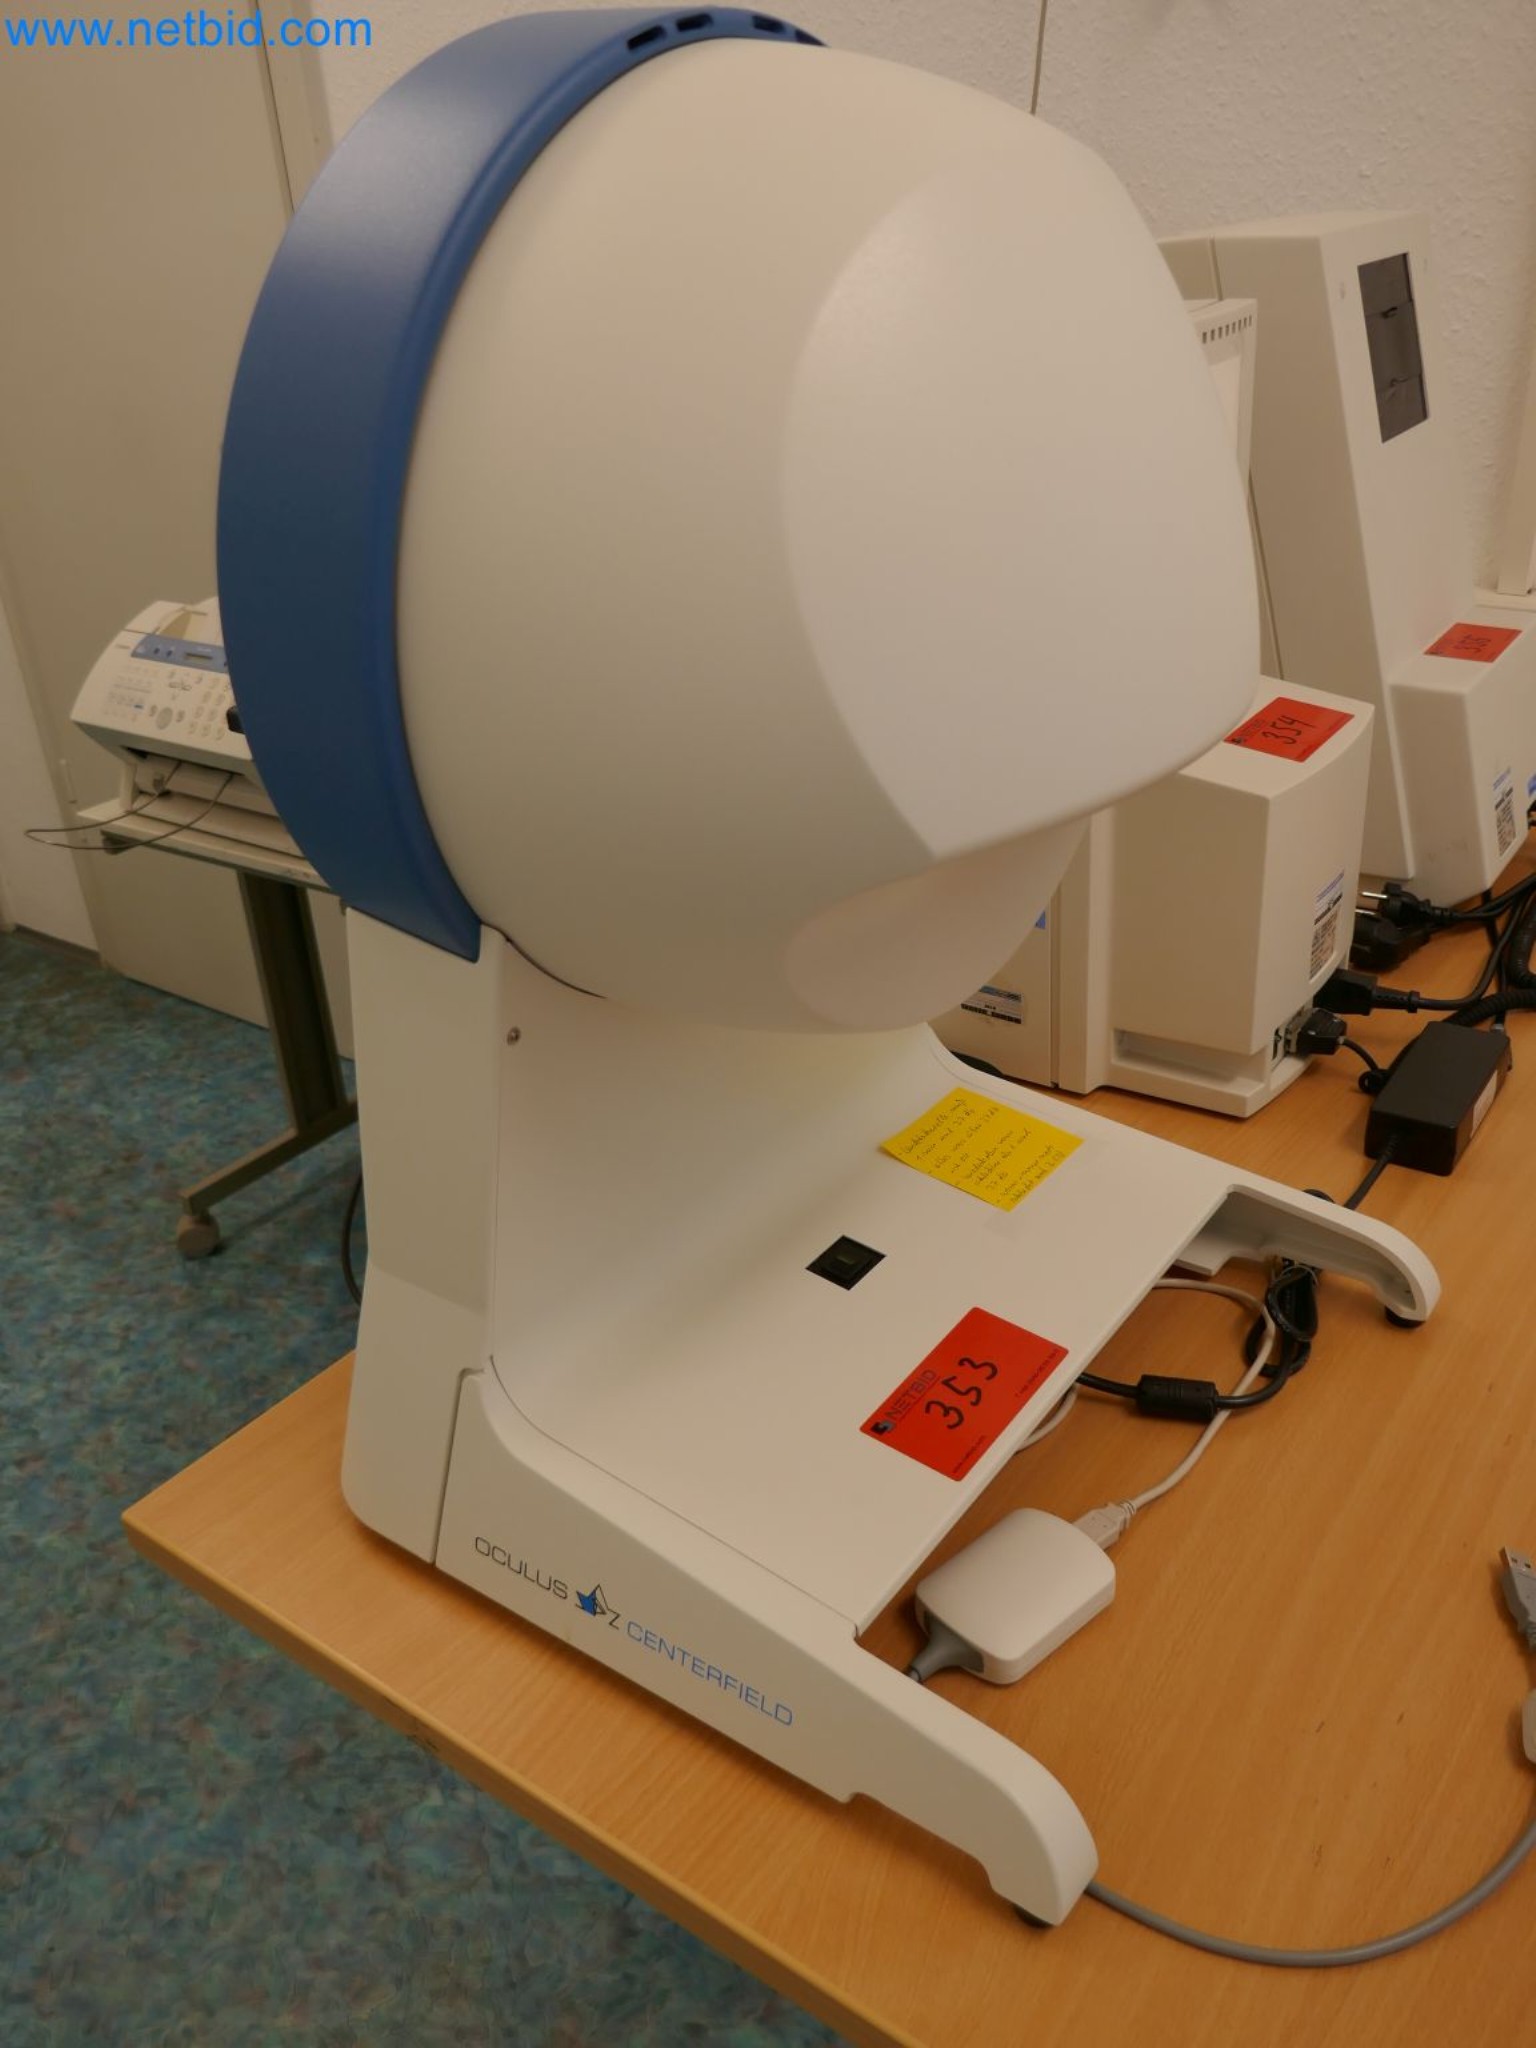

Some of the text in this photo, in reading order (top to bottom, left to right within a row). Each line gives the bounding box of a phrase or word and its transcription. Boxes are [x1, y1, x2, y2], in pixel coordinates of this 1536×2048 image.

[1262, 715, 1316, 745] 354
[885, 1369, 937, 1421] NETBID
[925, 1357, 998, 1430] 353
[475, 1536, 794, 1727] OCULUS CENTERFIELD
